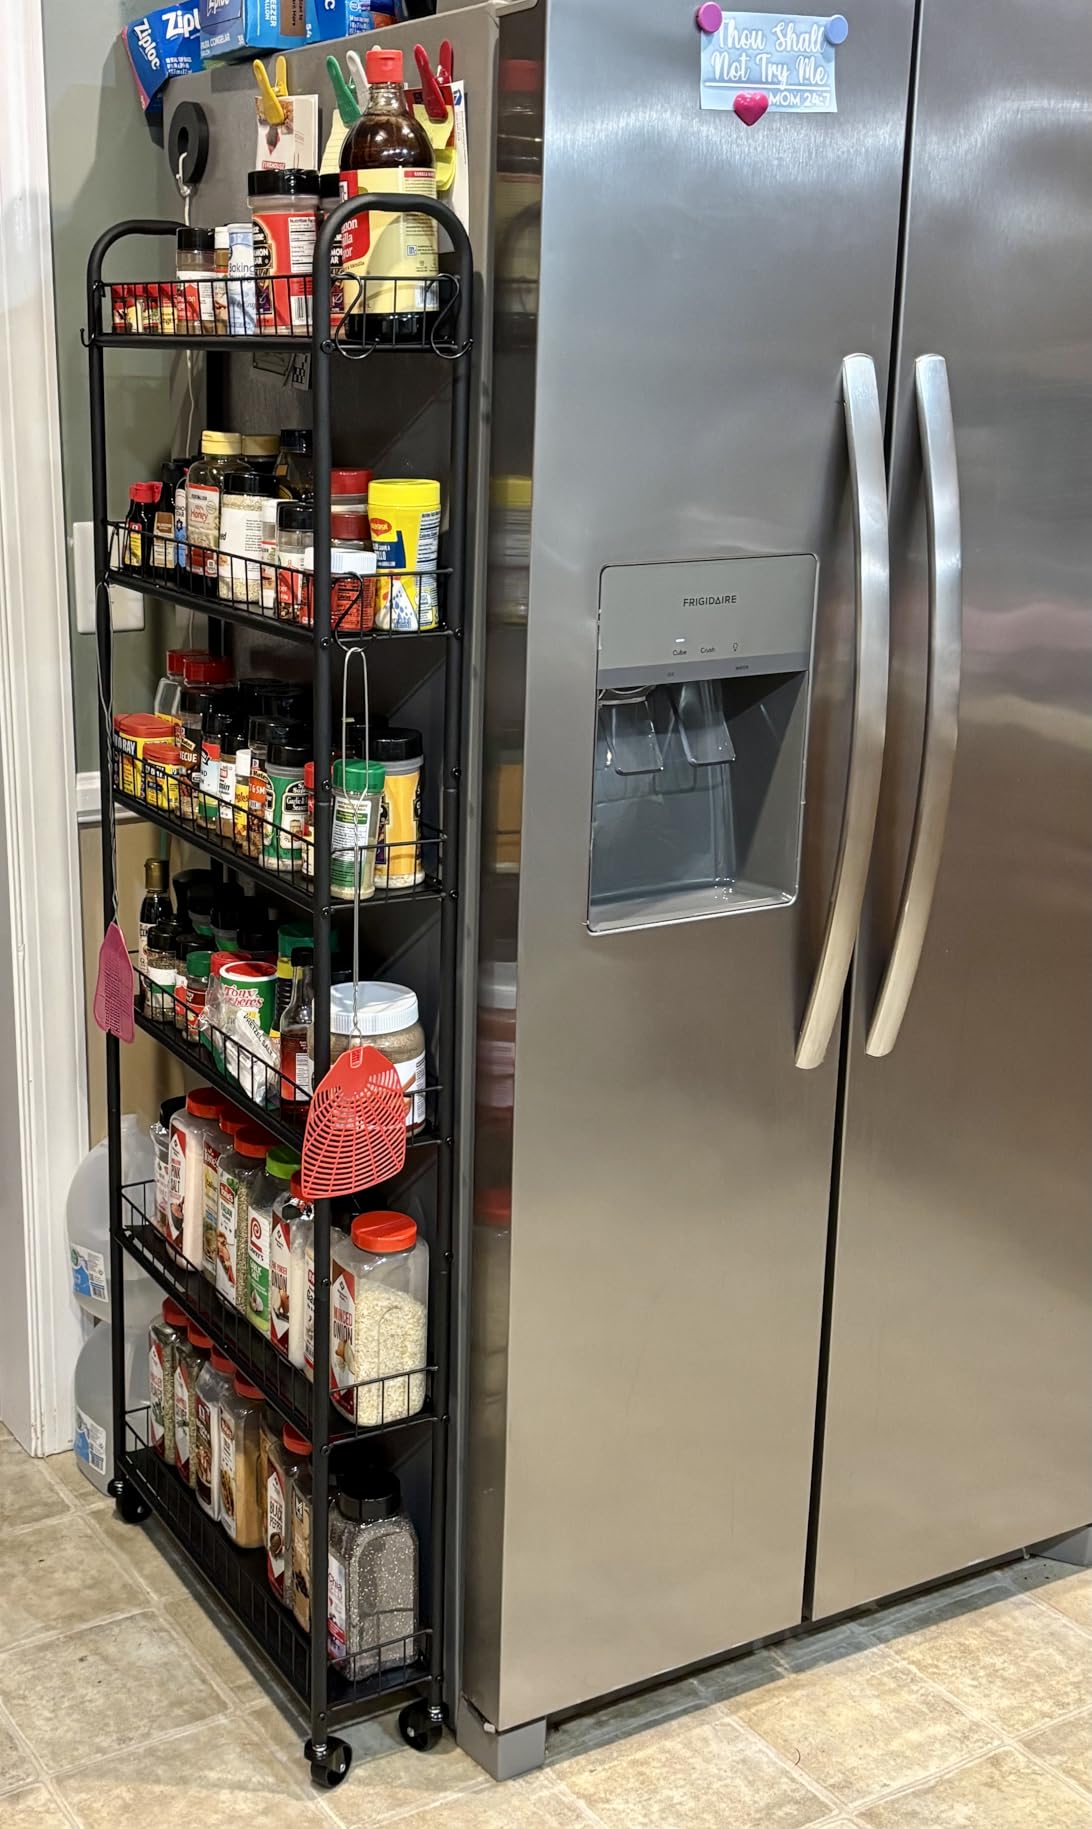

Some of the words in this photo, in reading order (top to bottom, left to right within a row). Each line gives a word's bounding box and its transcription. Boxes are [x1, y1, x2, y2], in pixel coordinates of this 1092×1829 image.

[161, 8, 200, 40] Zipl
[718, 18, 766, 50] Thou
[771, 21, 826, 52] Shall
[133, 17, 160, 70] Ziploc
[710, 51, 750, 81] Not
[756, 53, 790, 90] Try
[795, 55, 830, 85] Me
[768, 91, 801, 106] MOM
[190, 509, 209, 524] Honey
[683, 594, 737, 607] FRIGIDAIRE
[180, 751, 199, 763] ECUE
[333, 1303, 353, 1327] MINCED
[333, 1320, 353, 1346] ONION
